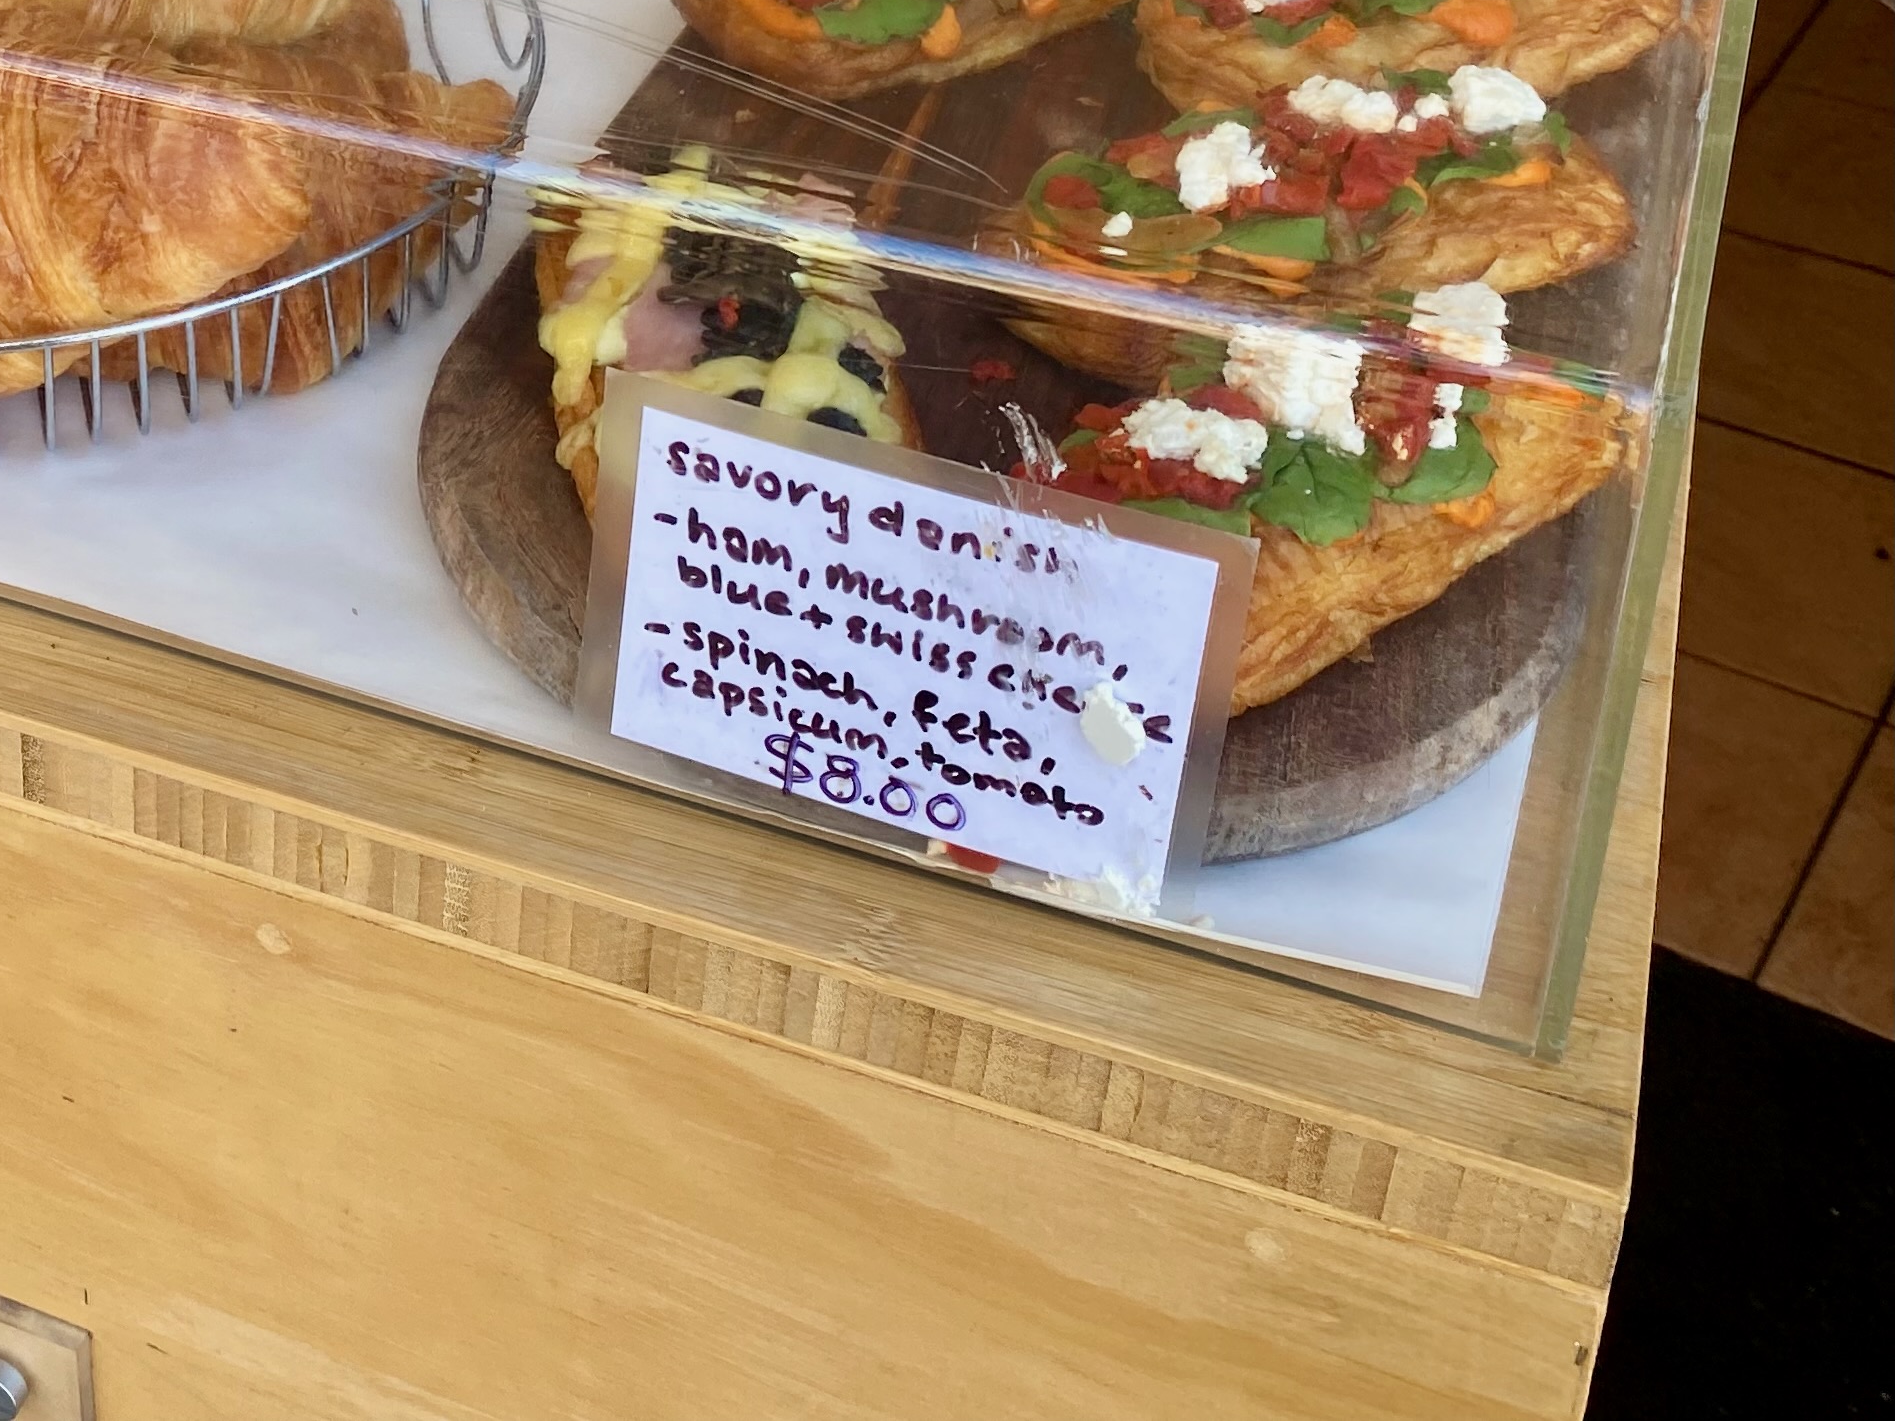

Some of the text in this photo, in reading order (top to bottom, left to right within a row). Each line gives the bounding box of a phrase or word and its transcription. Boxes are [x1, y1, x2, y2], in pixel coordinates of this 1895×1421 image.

[677, 555, 793, 616] blue
[845, 615, 977, 679] swiss
[764, 731, 968, 831] $8.00
[915, 741, 1105, 827] tomato
